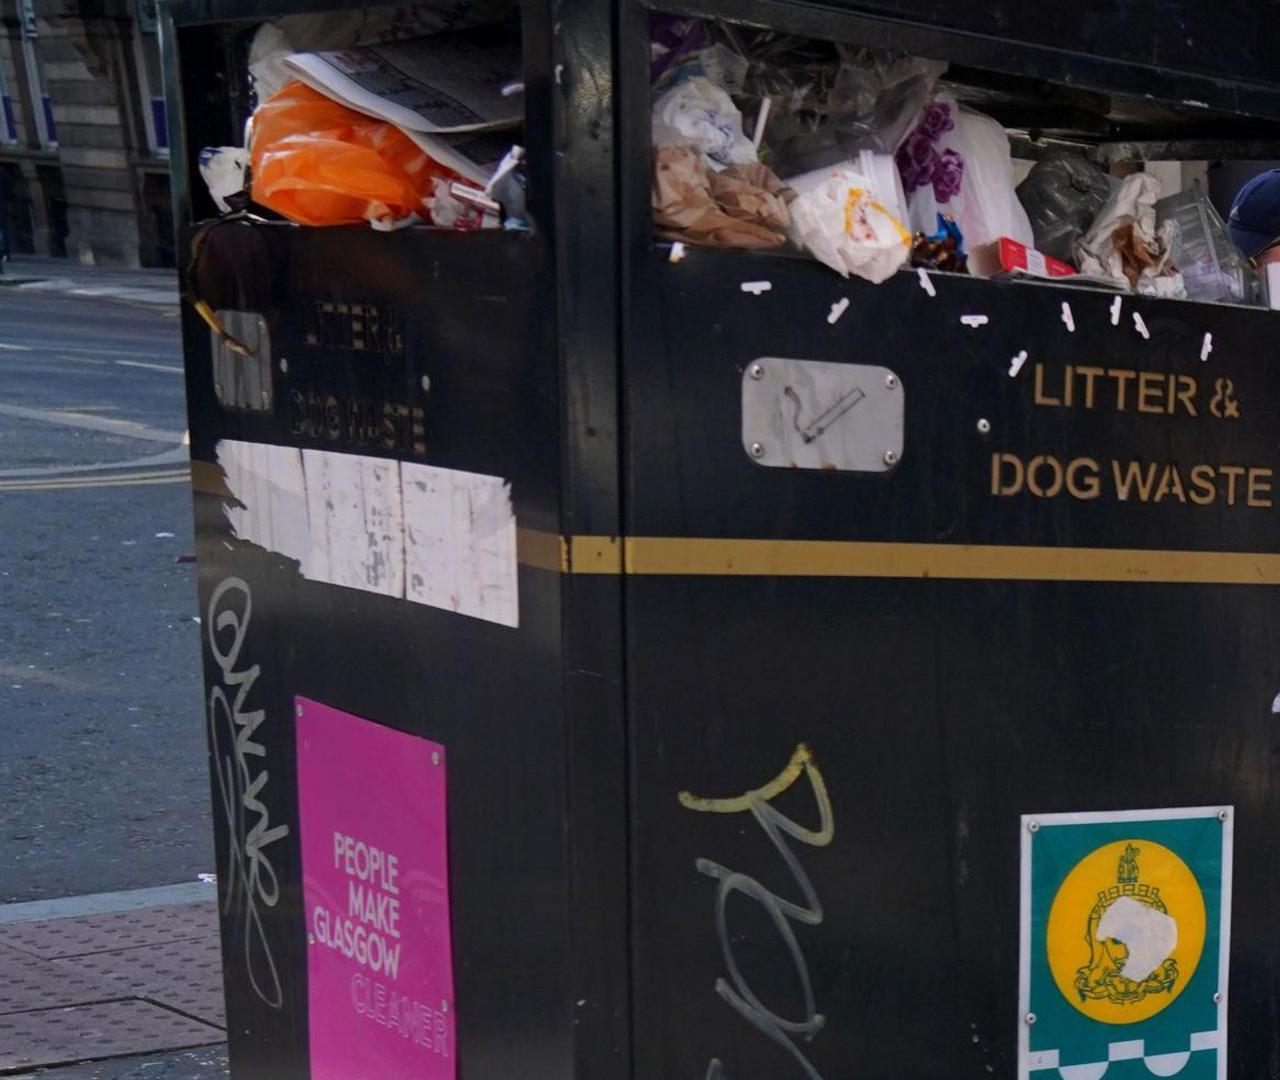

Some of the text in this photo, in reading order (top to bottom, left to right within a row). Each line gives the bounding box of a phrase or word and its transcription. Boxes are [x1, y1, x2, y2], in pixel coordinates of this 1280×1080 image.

[1034, 363, 1241, 419] LITTER &
[991, 452, 1274, 508] DOG WASTE
[334, 831, 399, 894] PEOPLE
[349, 881, 400, 939] MAKE
[313, 906, 400, 980] GLASGOW
[352, 973, 448, 1058] CLEANER
